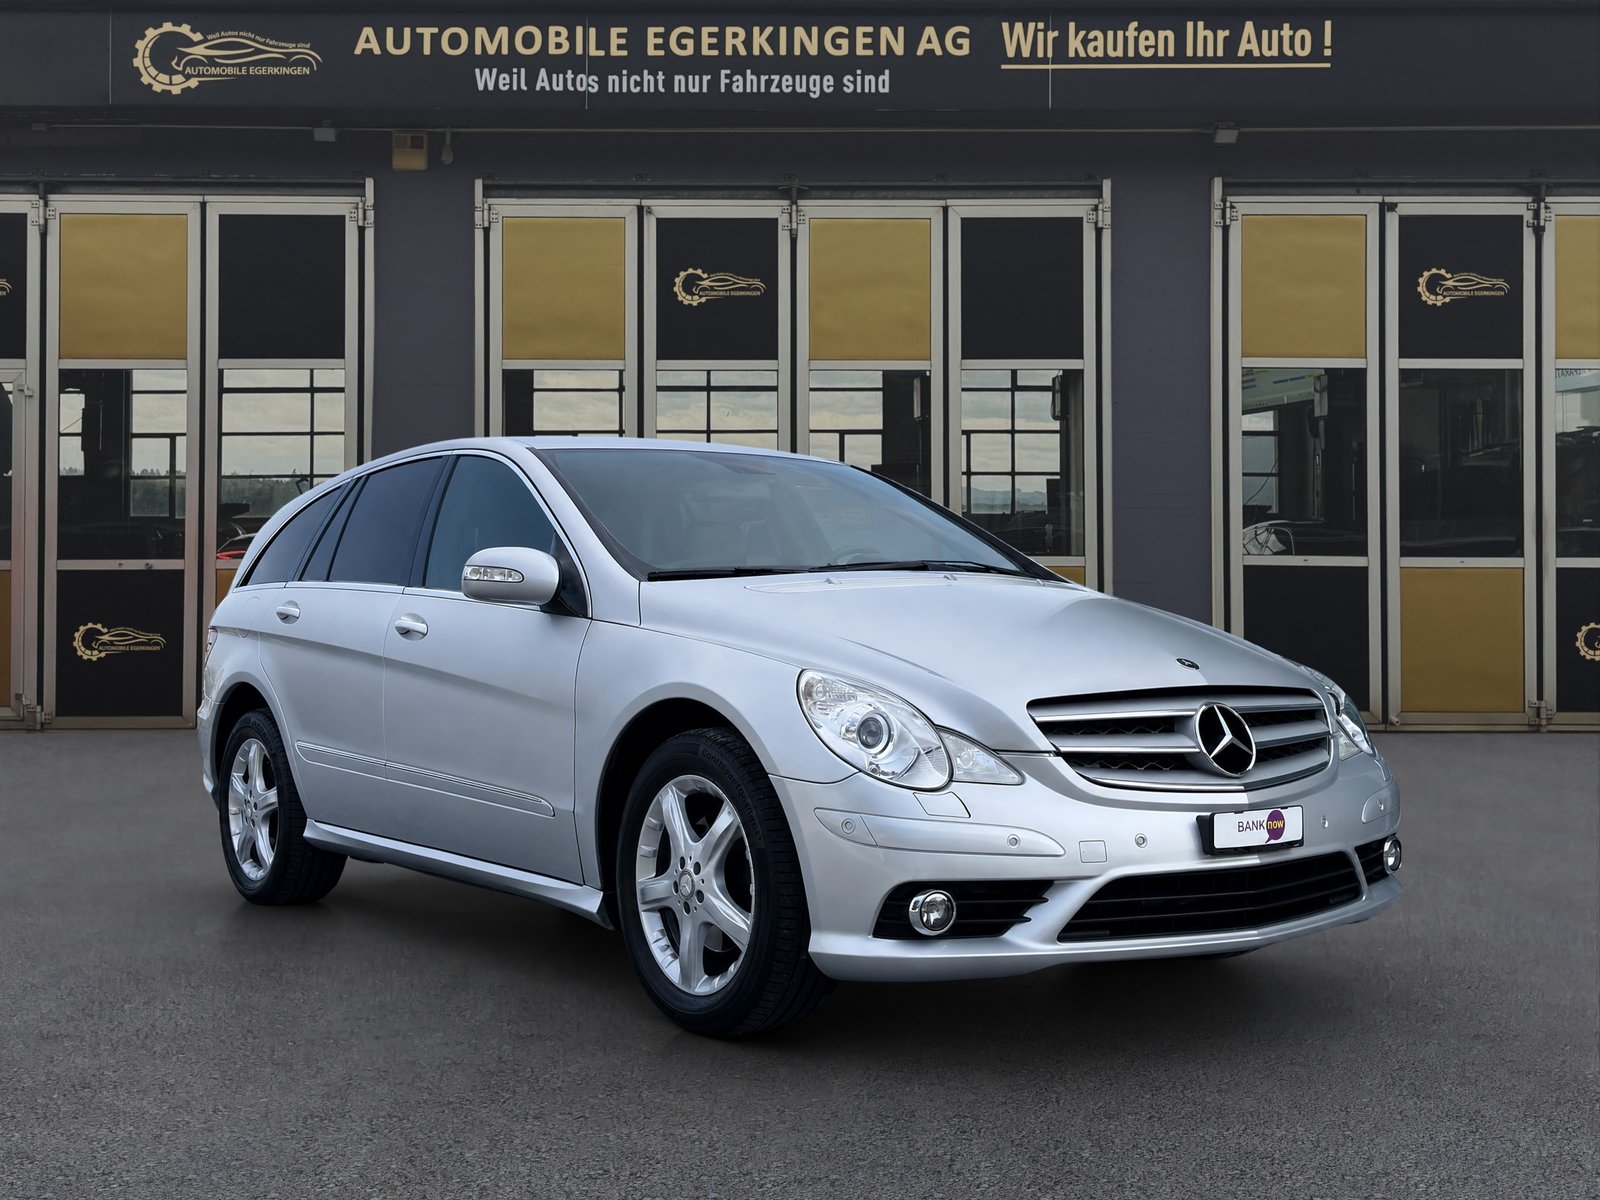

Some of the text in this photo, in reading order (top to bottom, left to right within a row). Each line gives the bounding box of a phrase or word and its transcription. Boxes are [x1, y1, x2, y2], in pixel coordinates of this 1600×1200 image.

[206, 32, 220, 40] Weil
[239, 30, 255, 39] nicht
[265, 38, 297, 49] Fahrzeuge
[353, 25, 971, 57] AUTOMOBILE EGERKINGEN AG
[1001, 21, 1059, 58] Wir
[1067, 20, 1175, 58] kaufen
[1185, 20, 1230, 58] Ihr
[1236, 20, 1312, 57] Auto
[184, 66, 310, 75] AUTOMOBILE EGERKINGEN
[474, 67, 890, 99] Weil Autos nicht nur Fahrzeuge sind
[1237, 819, 1284, 833] BANK now
